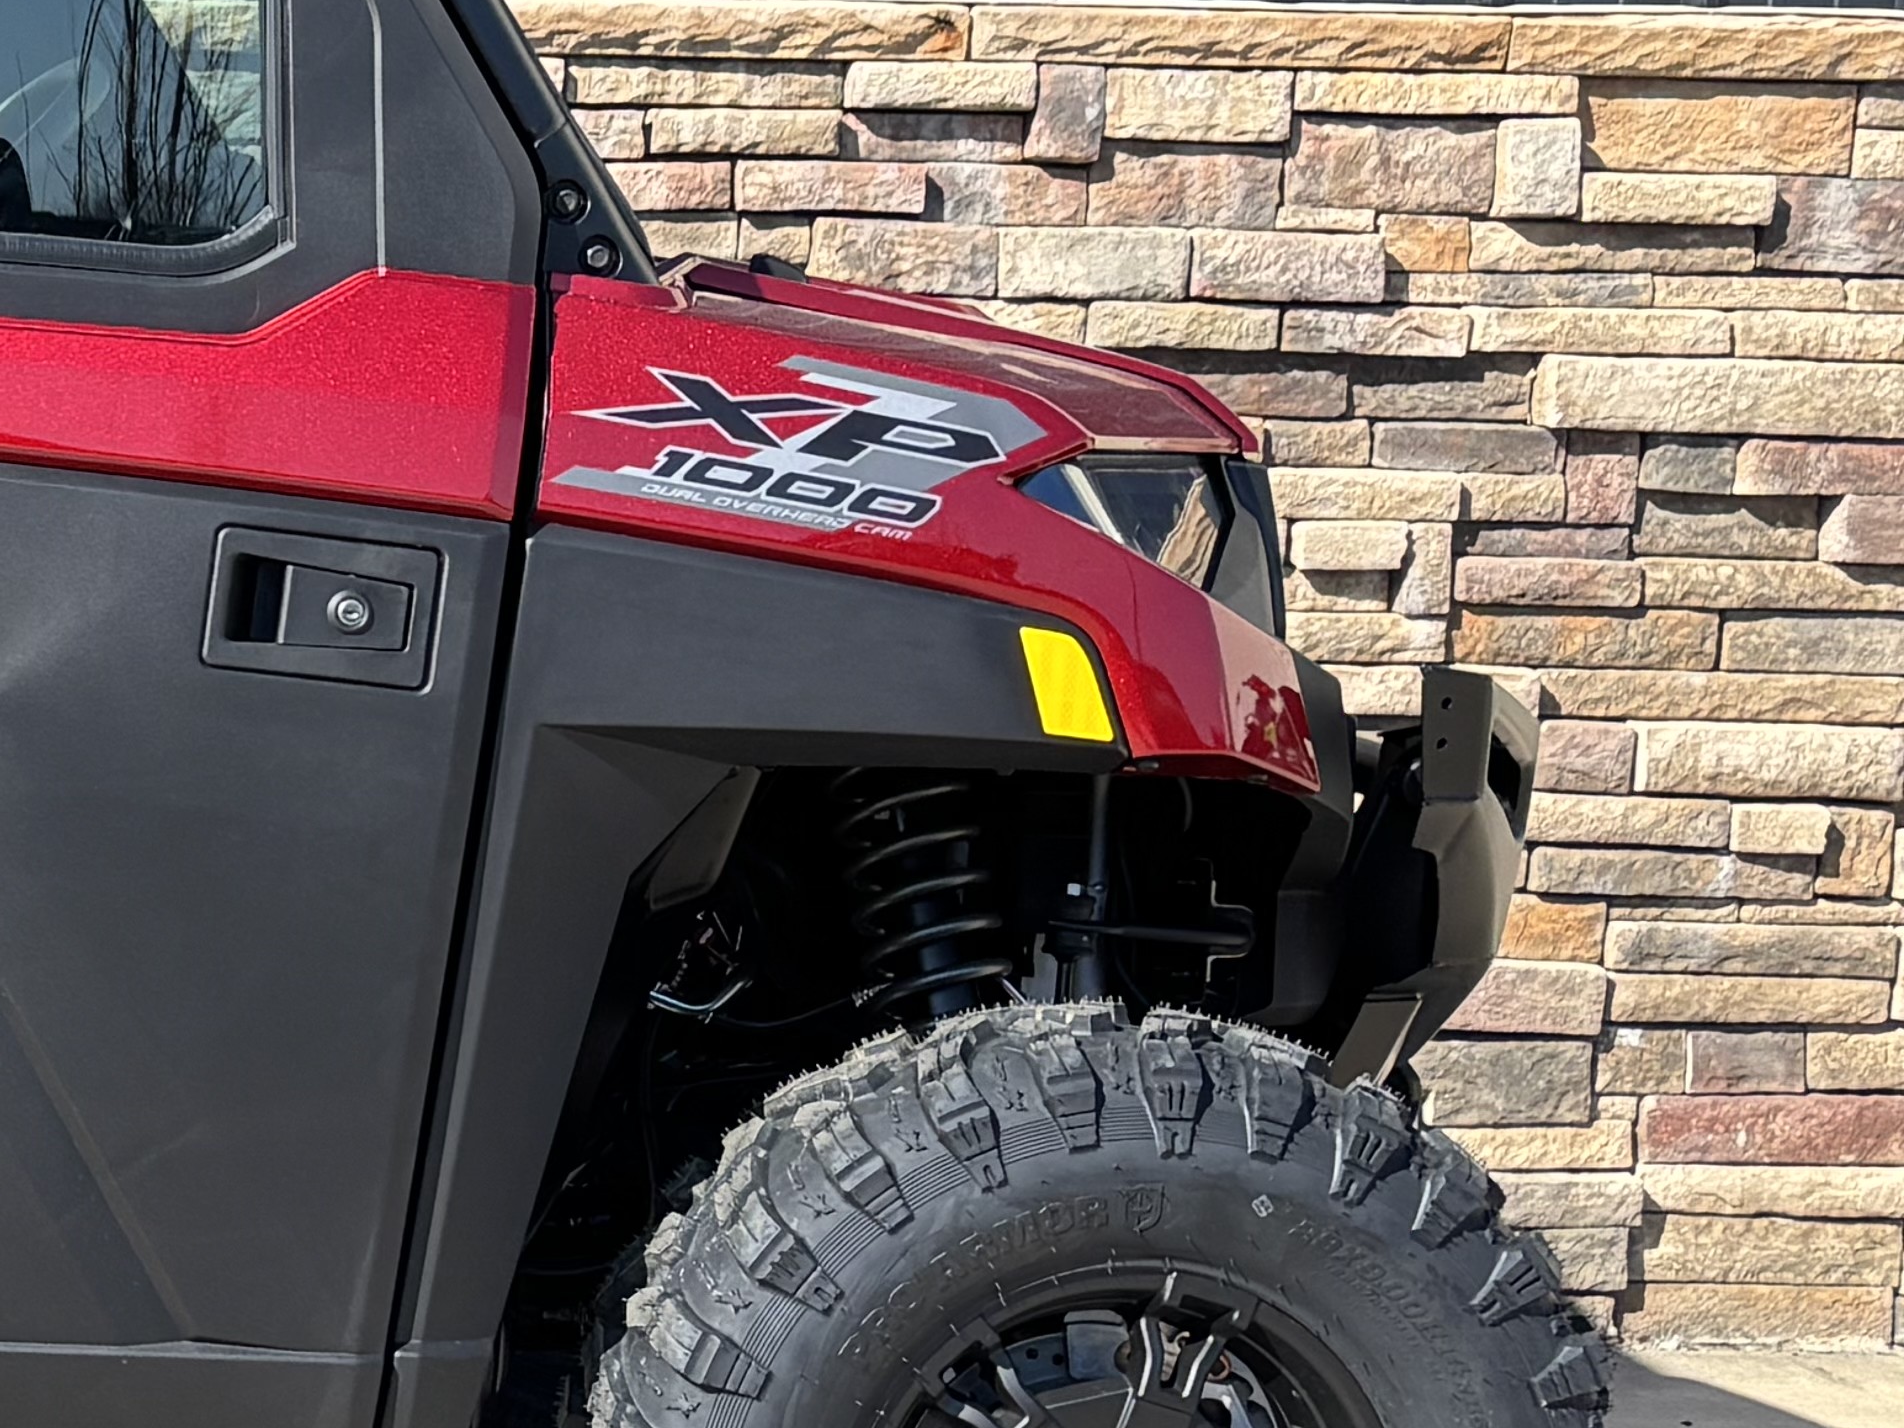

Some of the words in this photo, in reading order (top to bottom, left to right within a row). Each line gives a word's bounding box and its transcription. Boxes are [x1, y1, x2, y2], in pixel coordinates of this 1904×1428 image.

[572, 365, 1007, 468] XP
[640, 482, 708, 503] DUAL
[712, 496, 851, 528] OVERHEAD
[853, 521, 913, 540] CAM
[651, 446, 942, 526] 1000
[835, 1279, 924, 1370] PRO
[925, 1194, 1109, 1286] ARMOR
